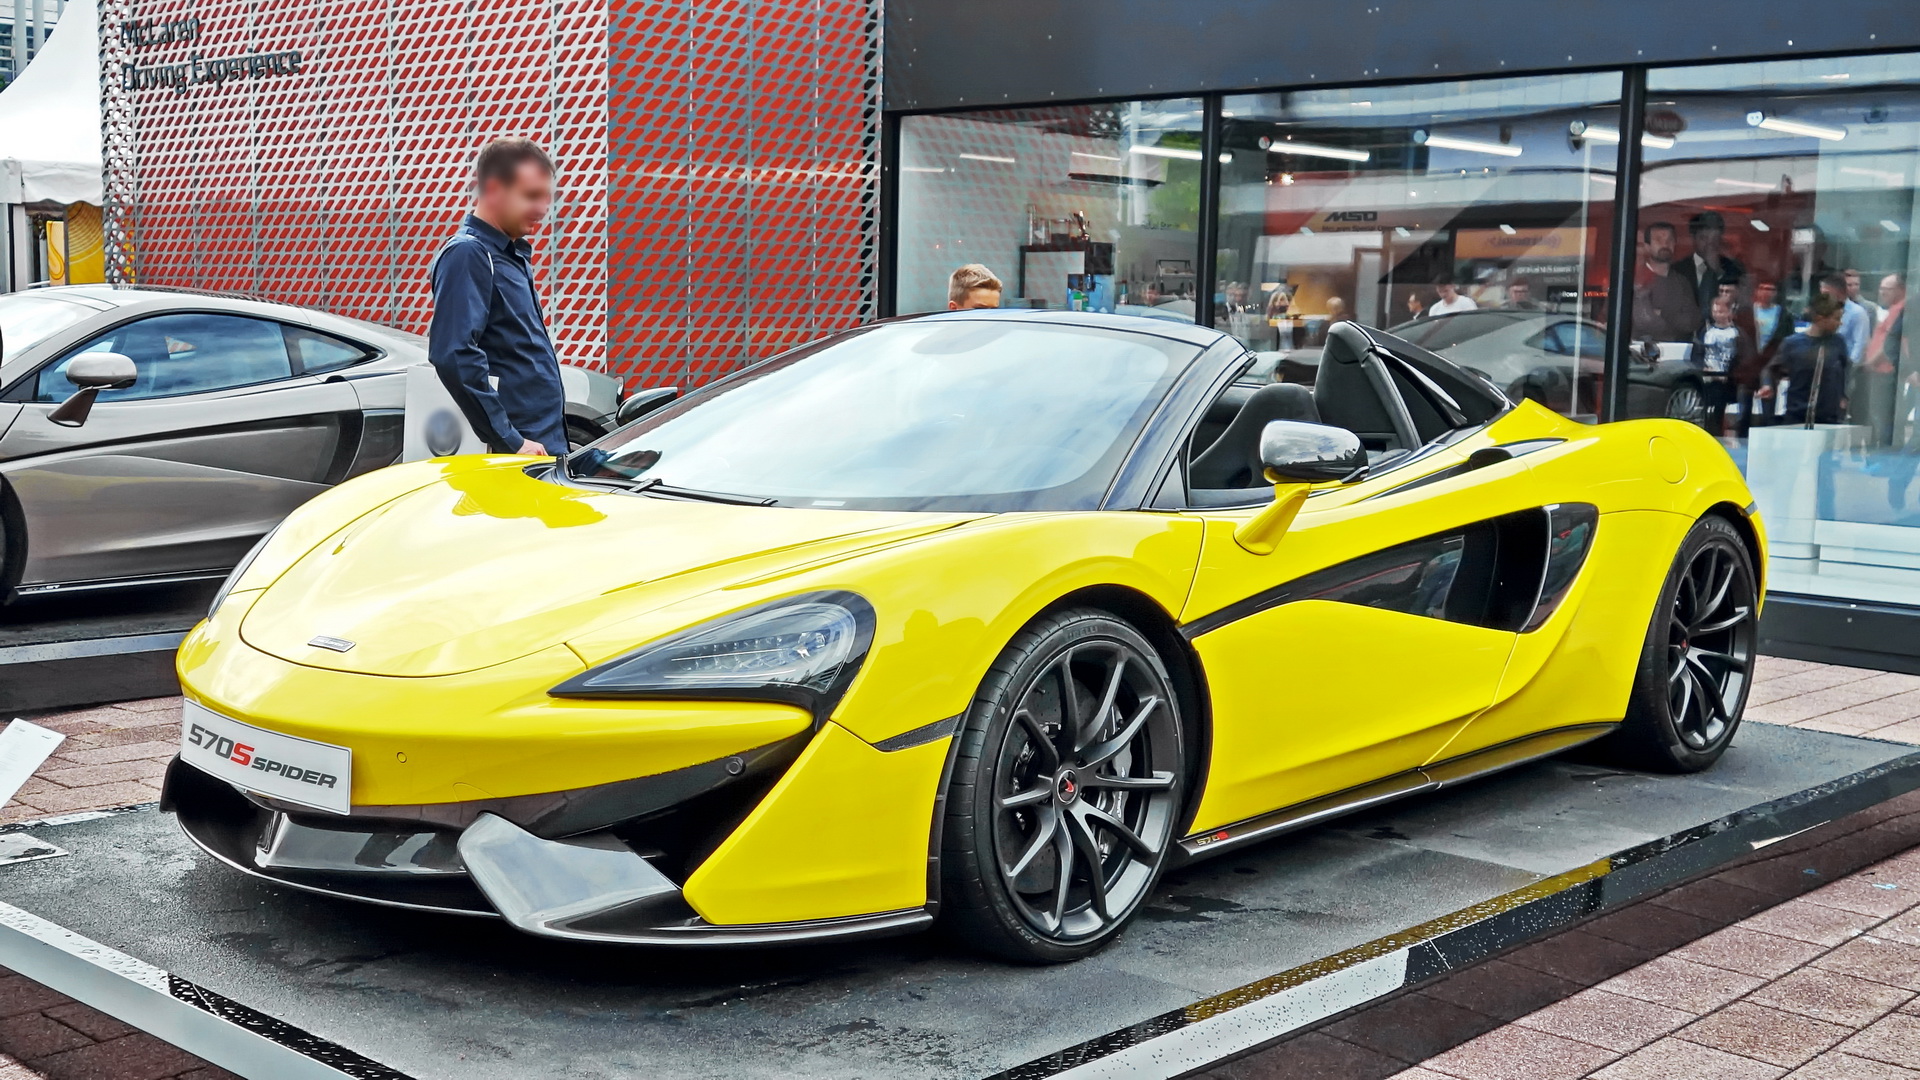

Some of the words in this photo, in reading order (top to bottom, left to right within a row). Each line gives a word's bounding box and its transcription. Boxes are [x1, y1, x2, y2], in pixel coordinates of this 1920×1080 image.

[120, 17, 200, 48] McLaren
[122, 61, 186, 95] Driving
[190, 50, 301, 91] Experience
[188, 723, 255, 766] 570S
[251, 756, 338, 789] SPIDER
